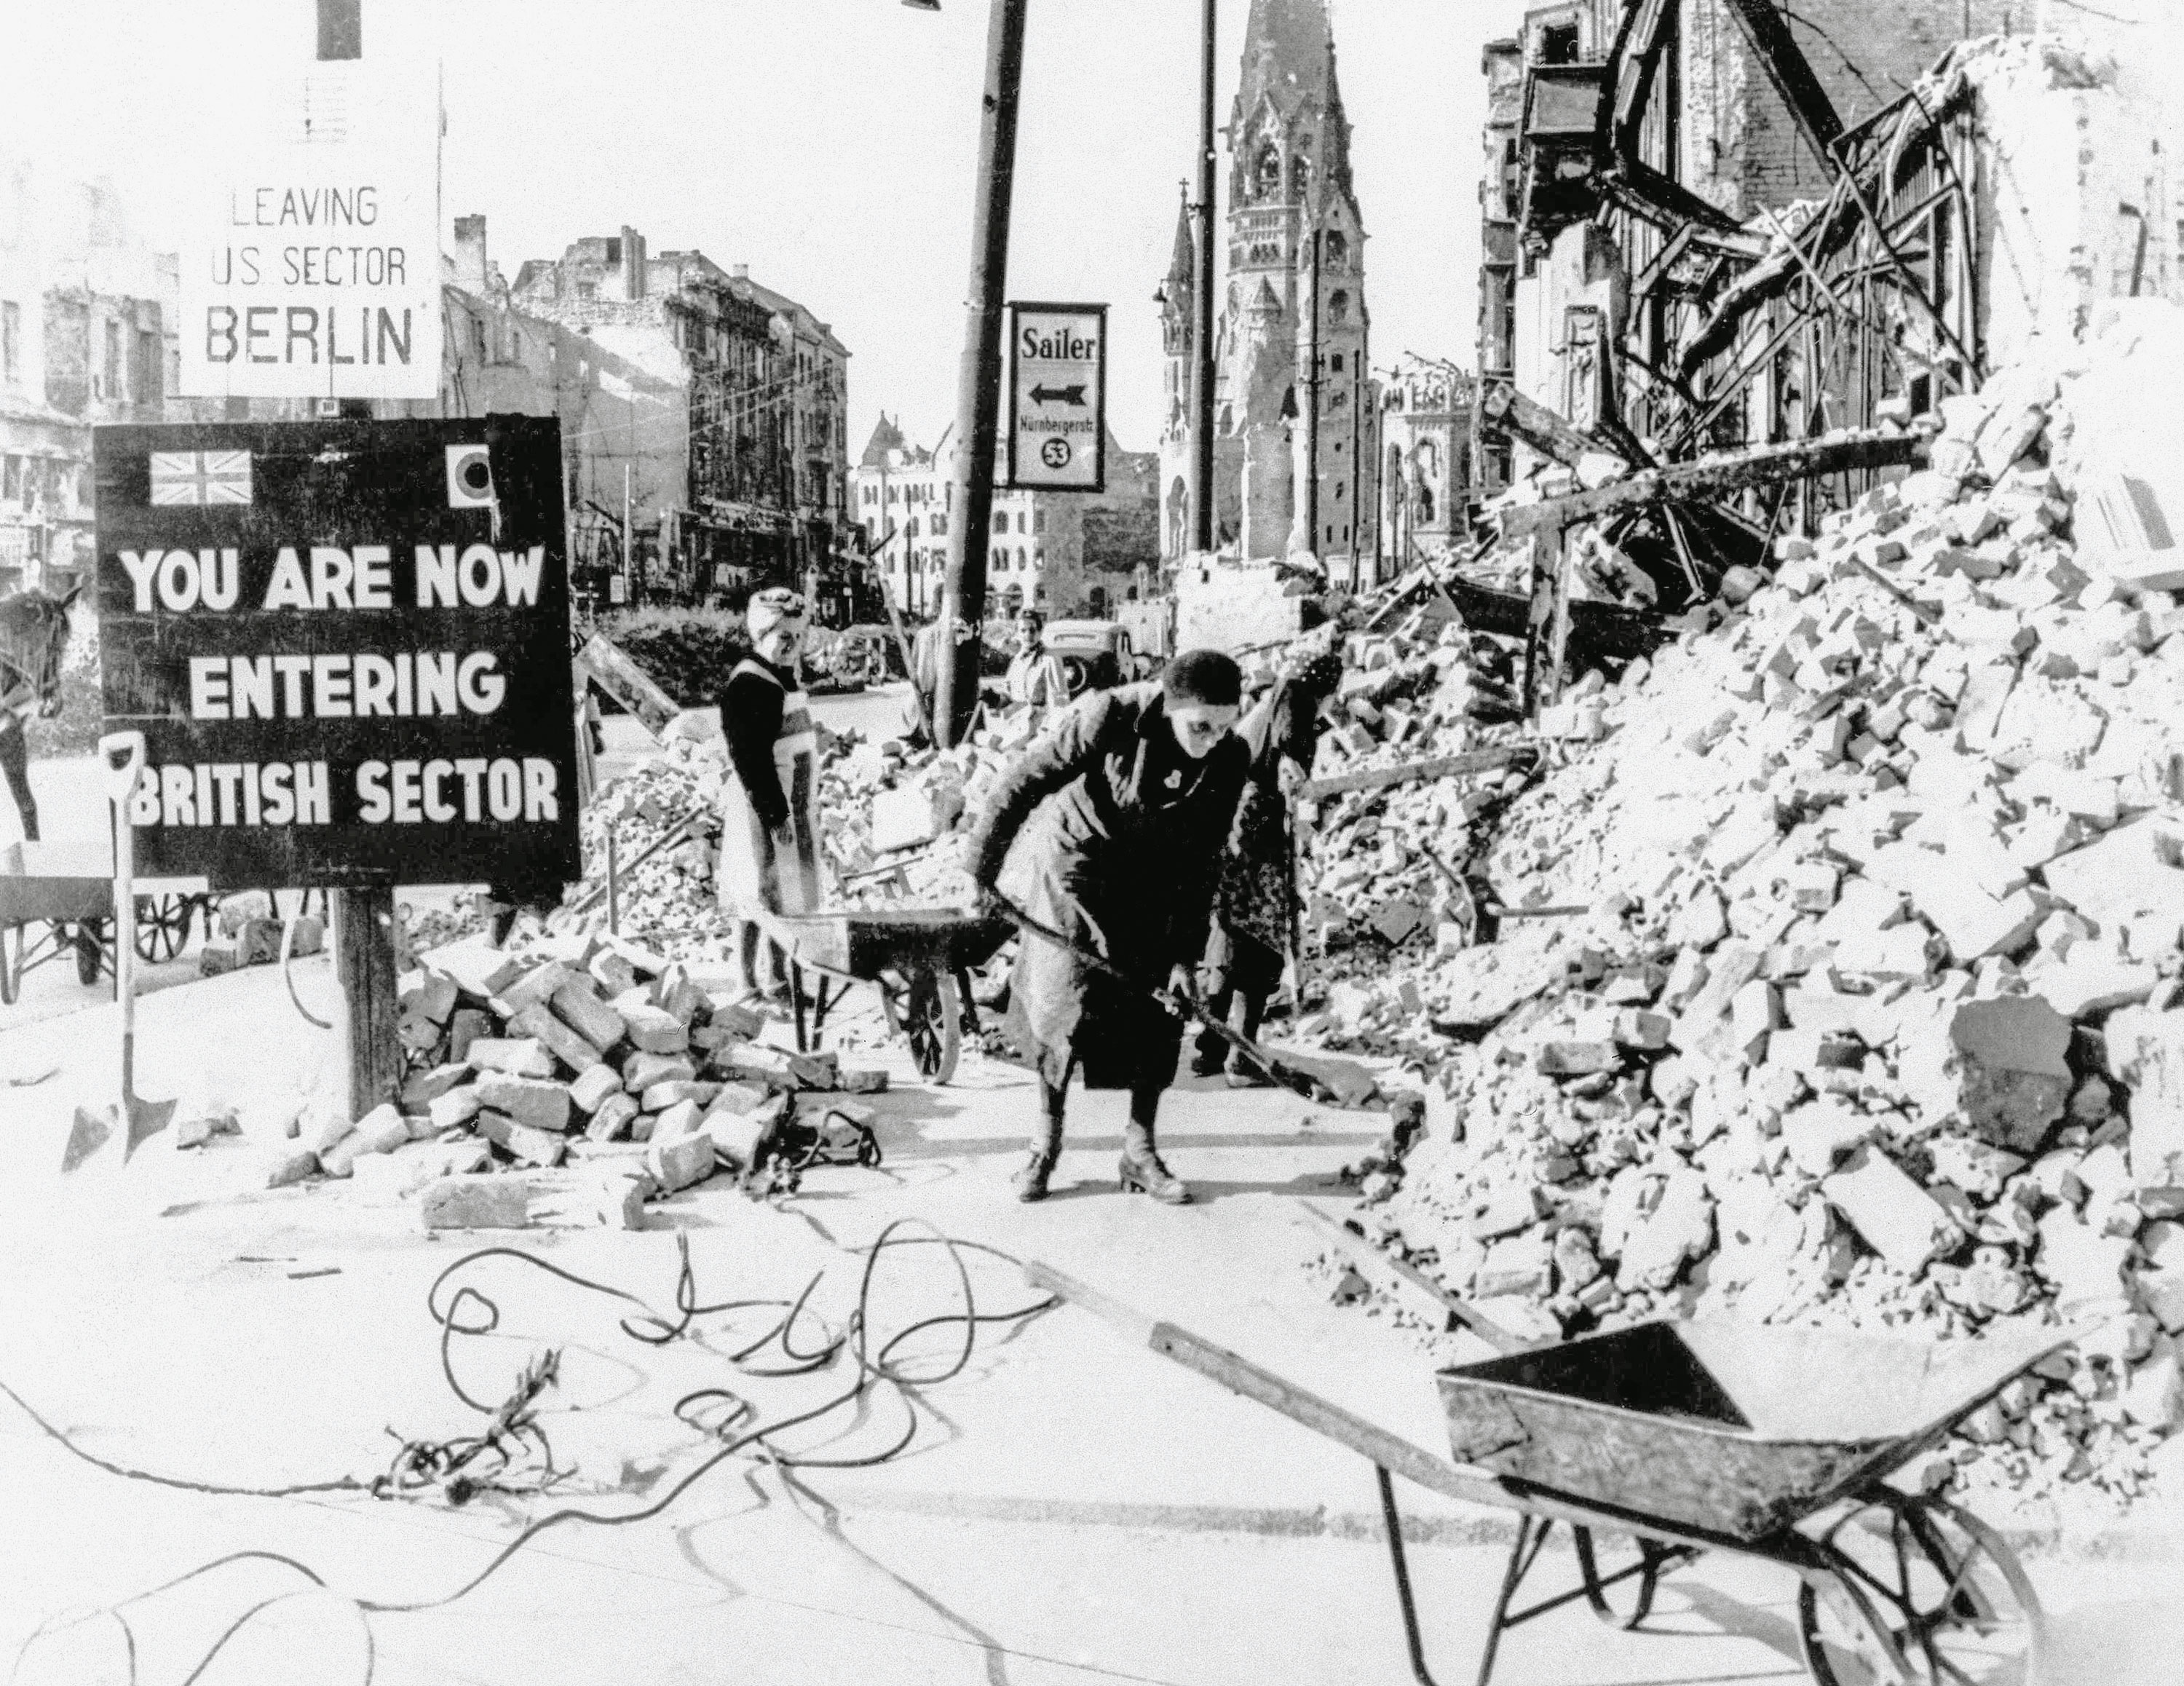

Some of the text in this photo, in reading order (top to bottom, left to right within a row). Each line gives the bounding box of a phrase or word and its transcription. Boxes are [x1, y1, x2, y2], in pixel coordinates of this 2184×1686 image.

[232, 186, 377, 226] LEAVING
[212, 247, 405, 285] US SECTOR
[207, 306, 411, 365] BERLIN
[1021, 328, 1095, 359] Sailer
[1045, 443, 1067, 464] 53
[119, 548, 239, 612] YOU
[264, 547, 392, 609] ARE
[415, 544, 545, 608] NOW
[191, 652, 506, 719] ENTERING
[130, 757, 559, 826] BRITISH SECTOR
